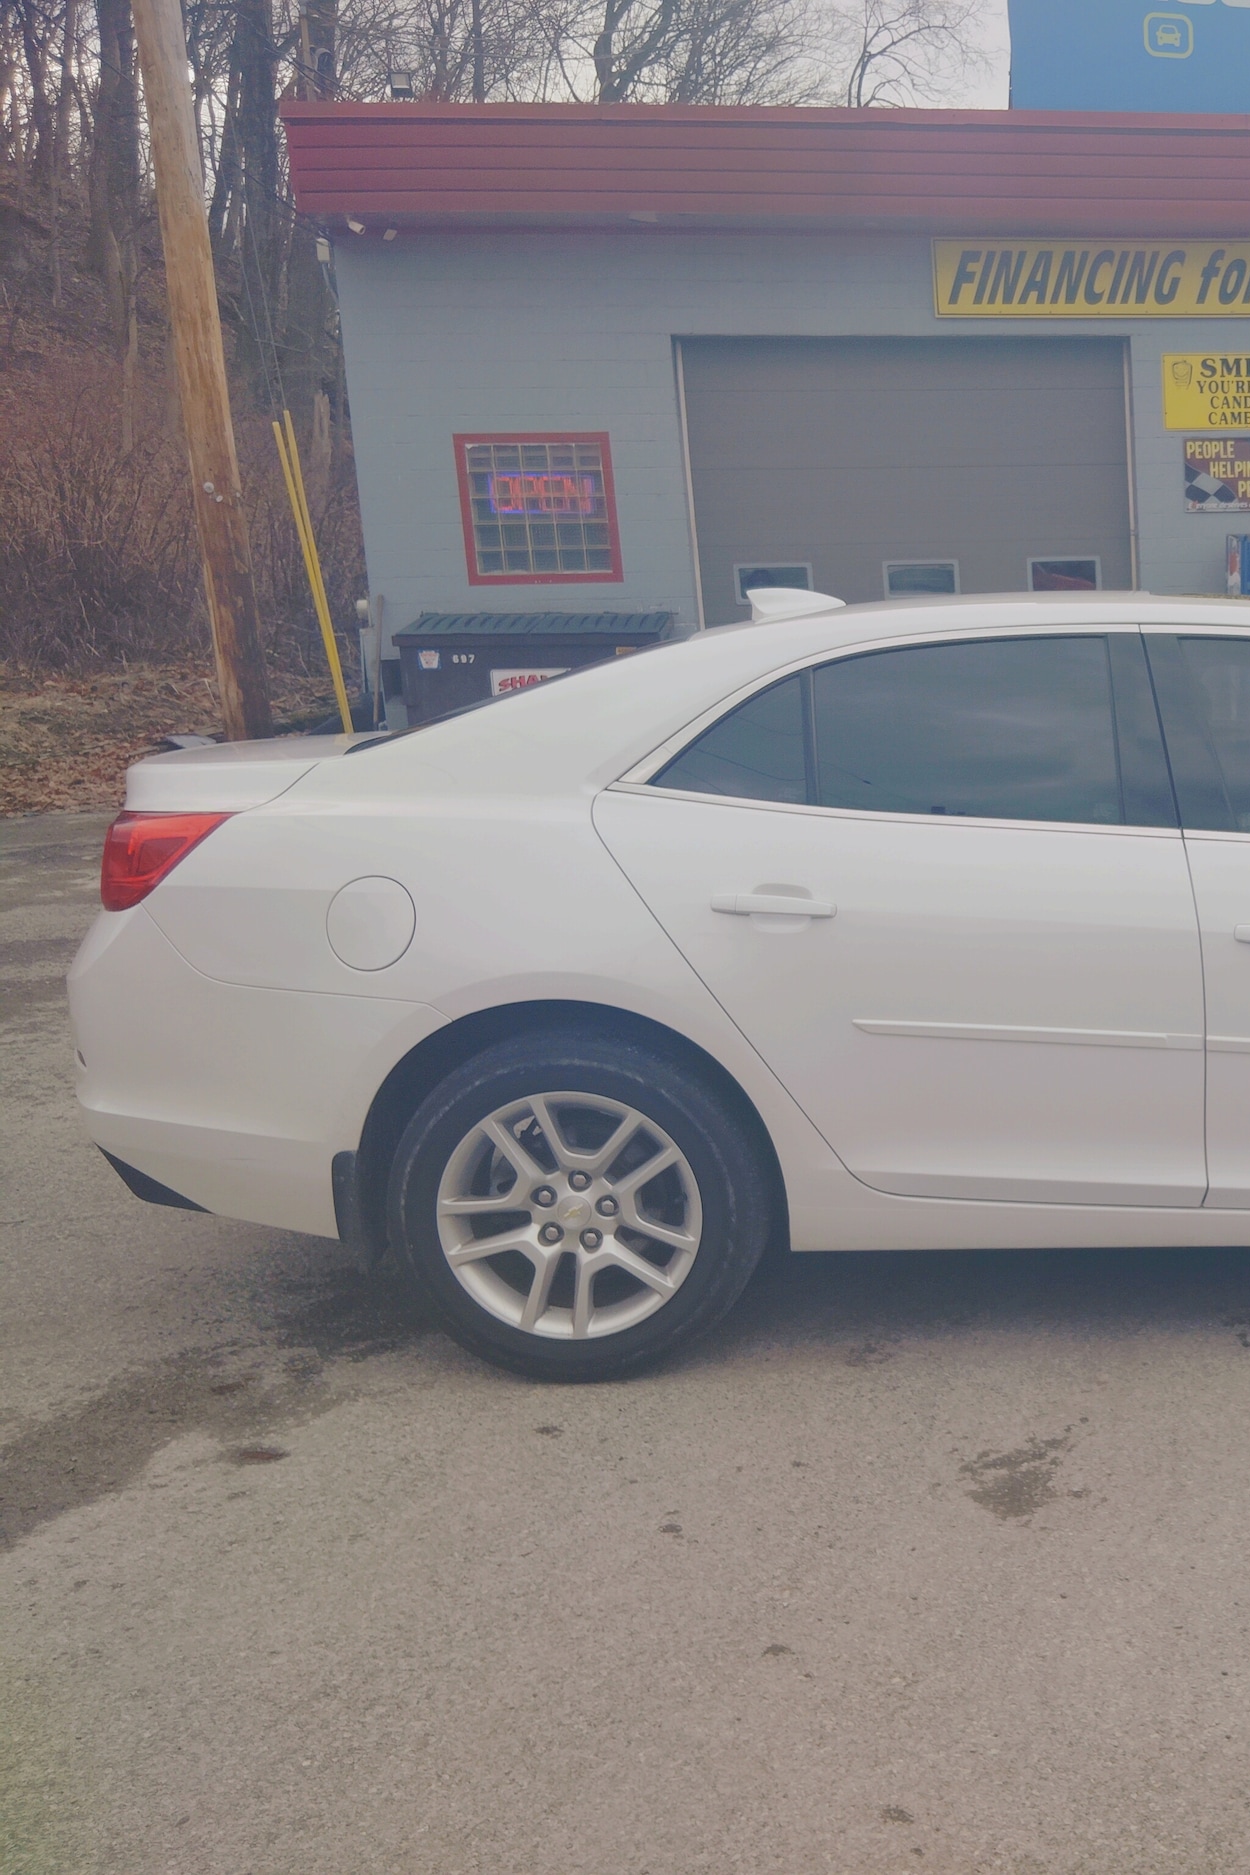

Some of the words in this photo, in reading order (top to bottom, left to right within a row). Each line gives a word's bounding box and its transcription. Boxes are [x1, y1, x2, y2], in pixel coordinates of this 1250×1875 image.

[947, 249, 1187, 306] FINANCING
[1186, 441, 1235, 459] PEOPLE
[492, 476, 593, 512] OPEN
